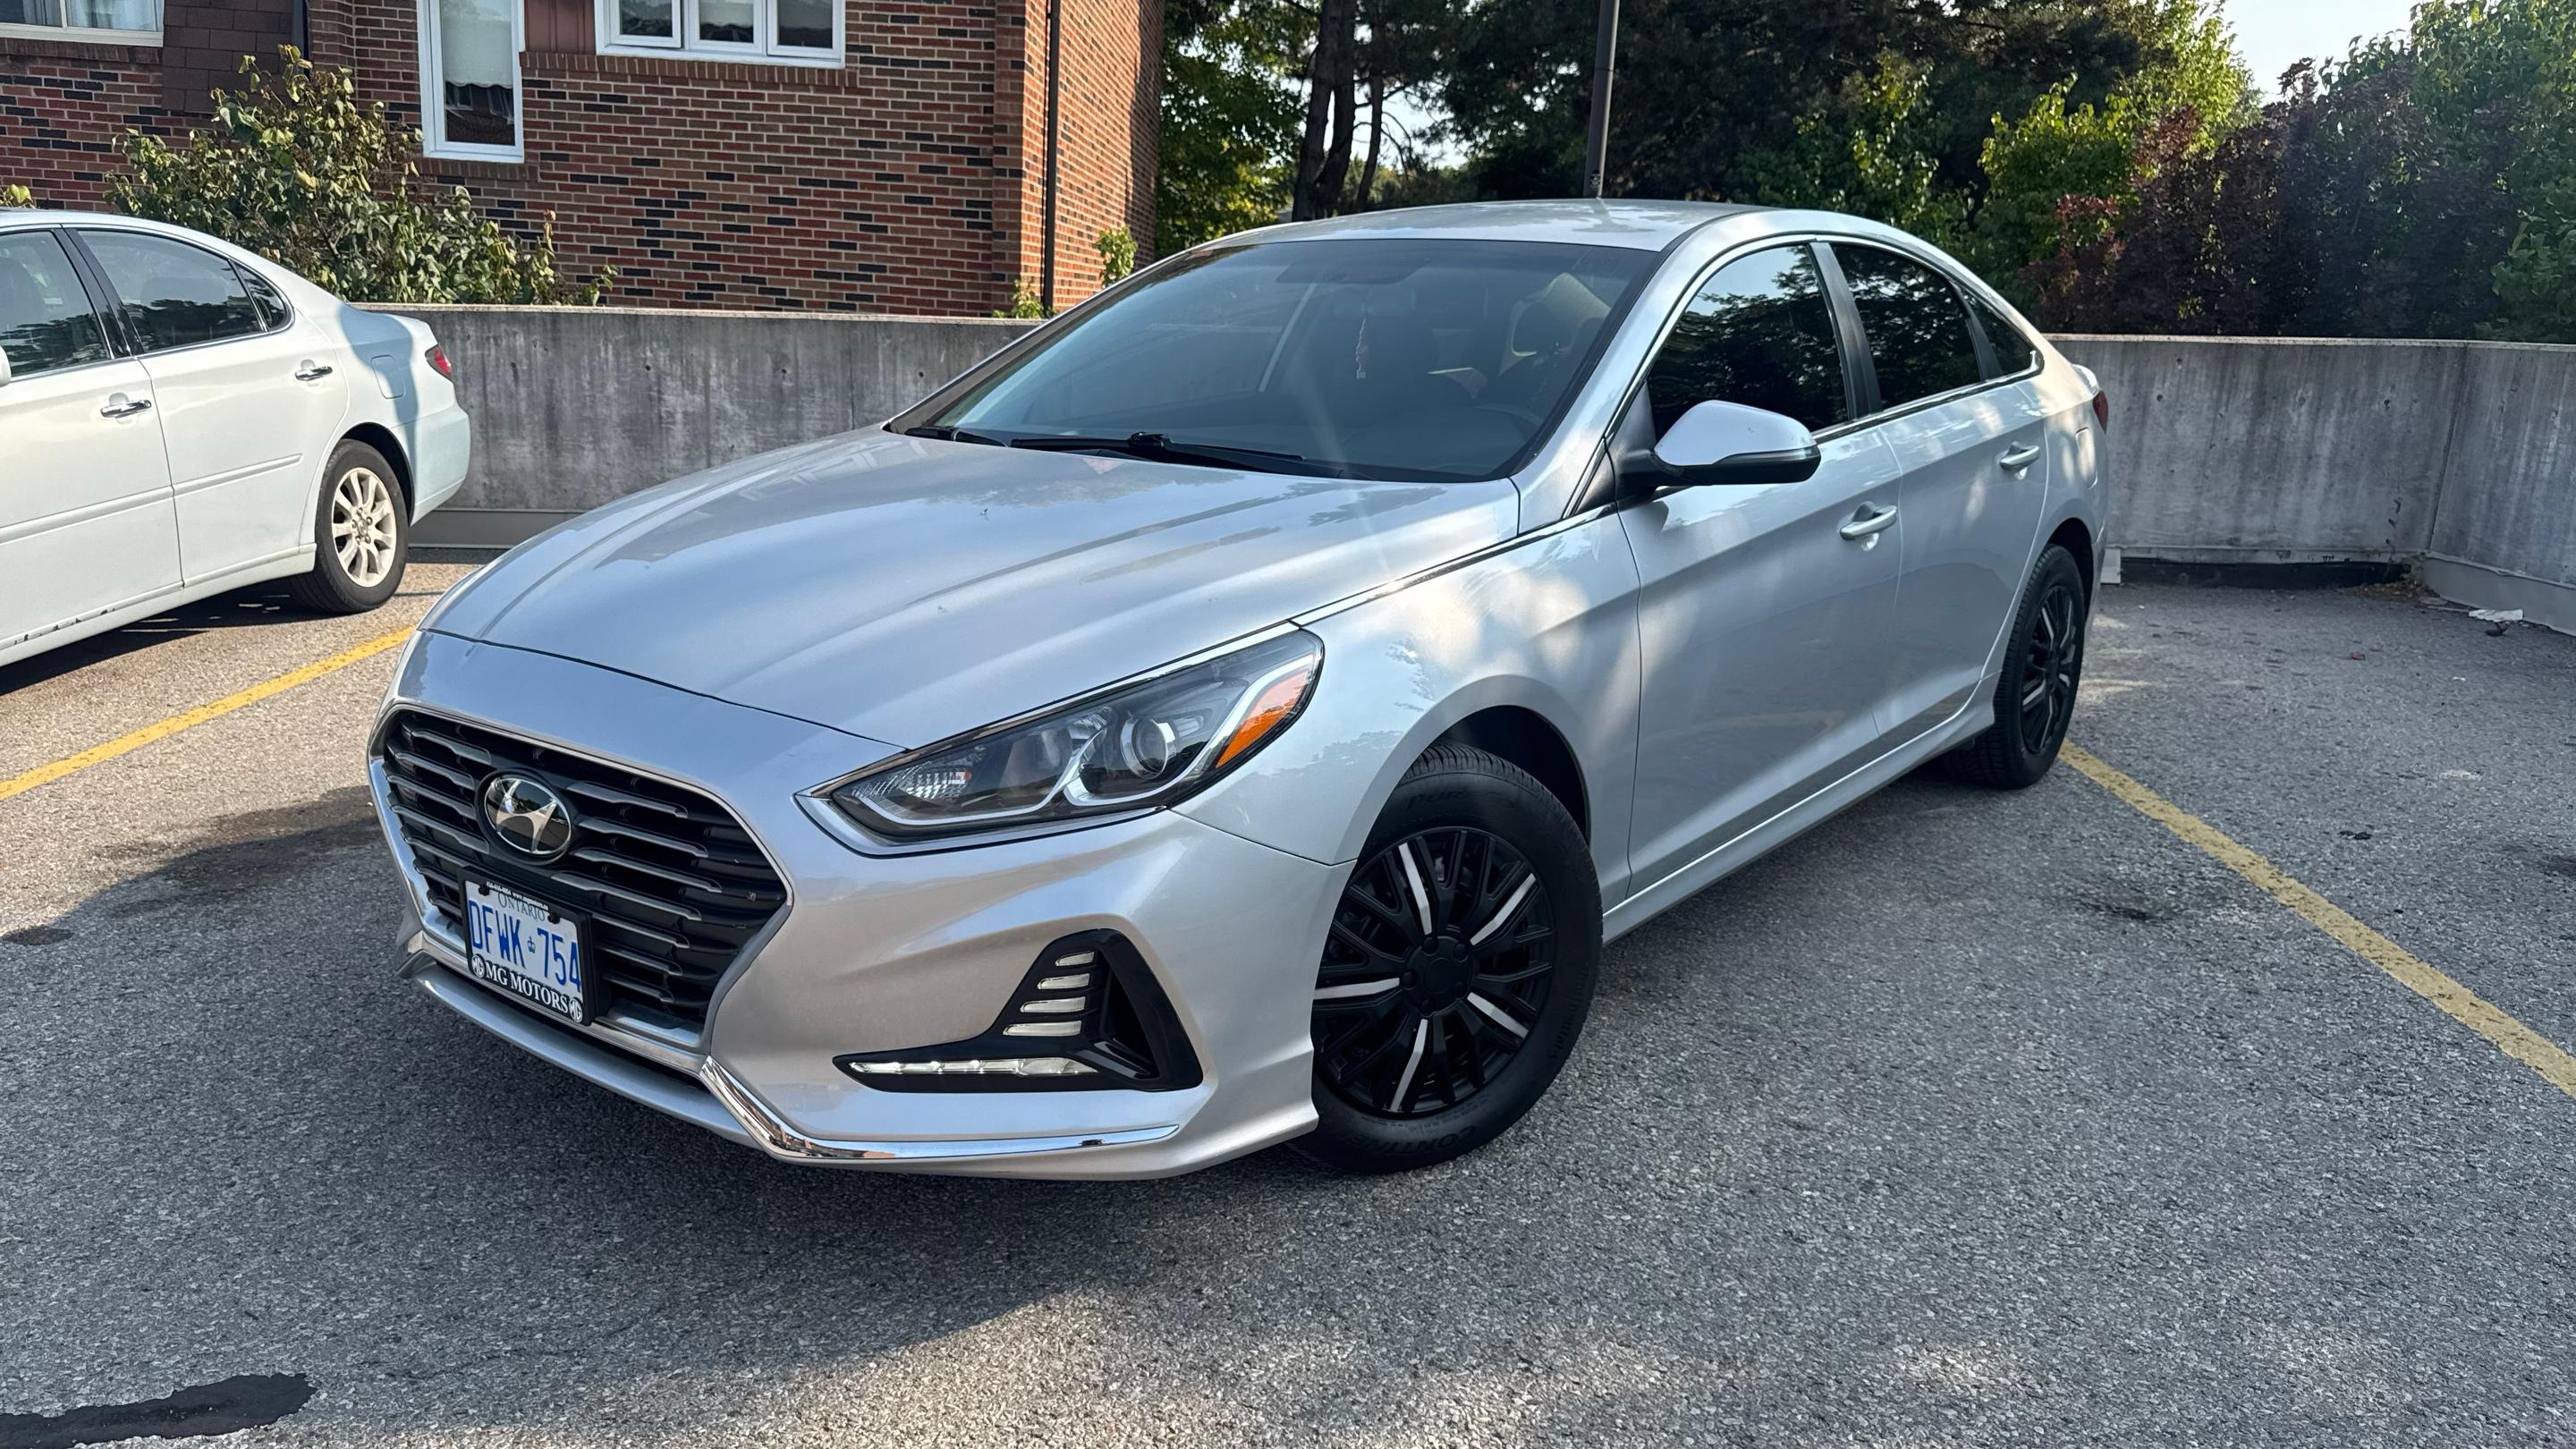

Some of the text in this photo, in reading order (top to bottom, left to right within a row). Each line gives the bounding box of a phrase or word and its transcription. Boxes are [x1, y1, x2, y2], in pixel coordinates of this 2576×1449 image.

[497, 893, 546, 922] ONTARIO
[469, 900, 581, 994] DFWK 754
[485, 961, 508, 986] MG
[510, 971, 569, 1014] MOTORS
